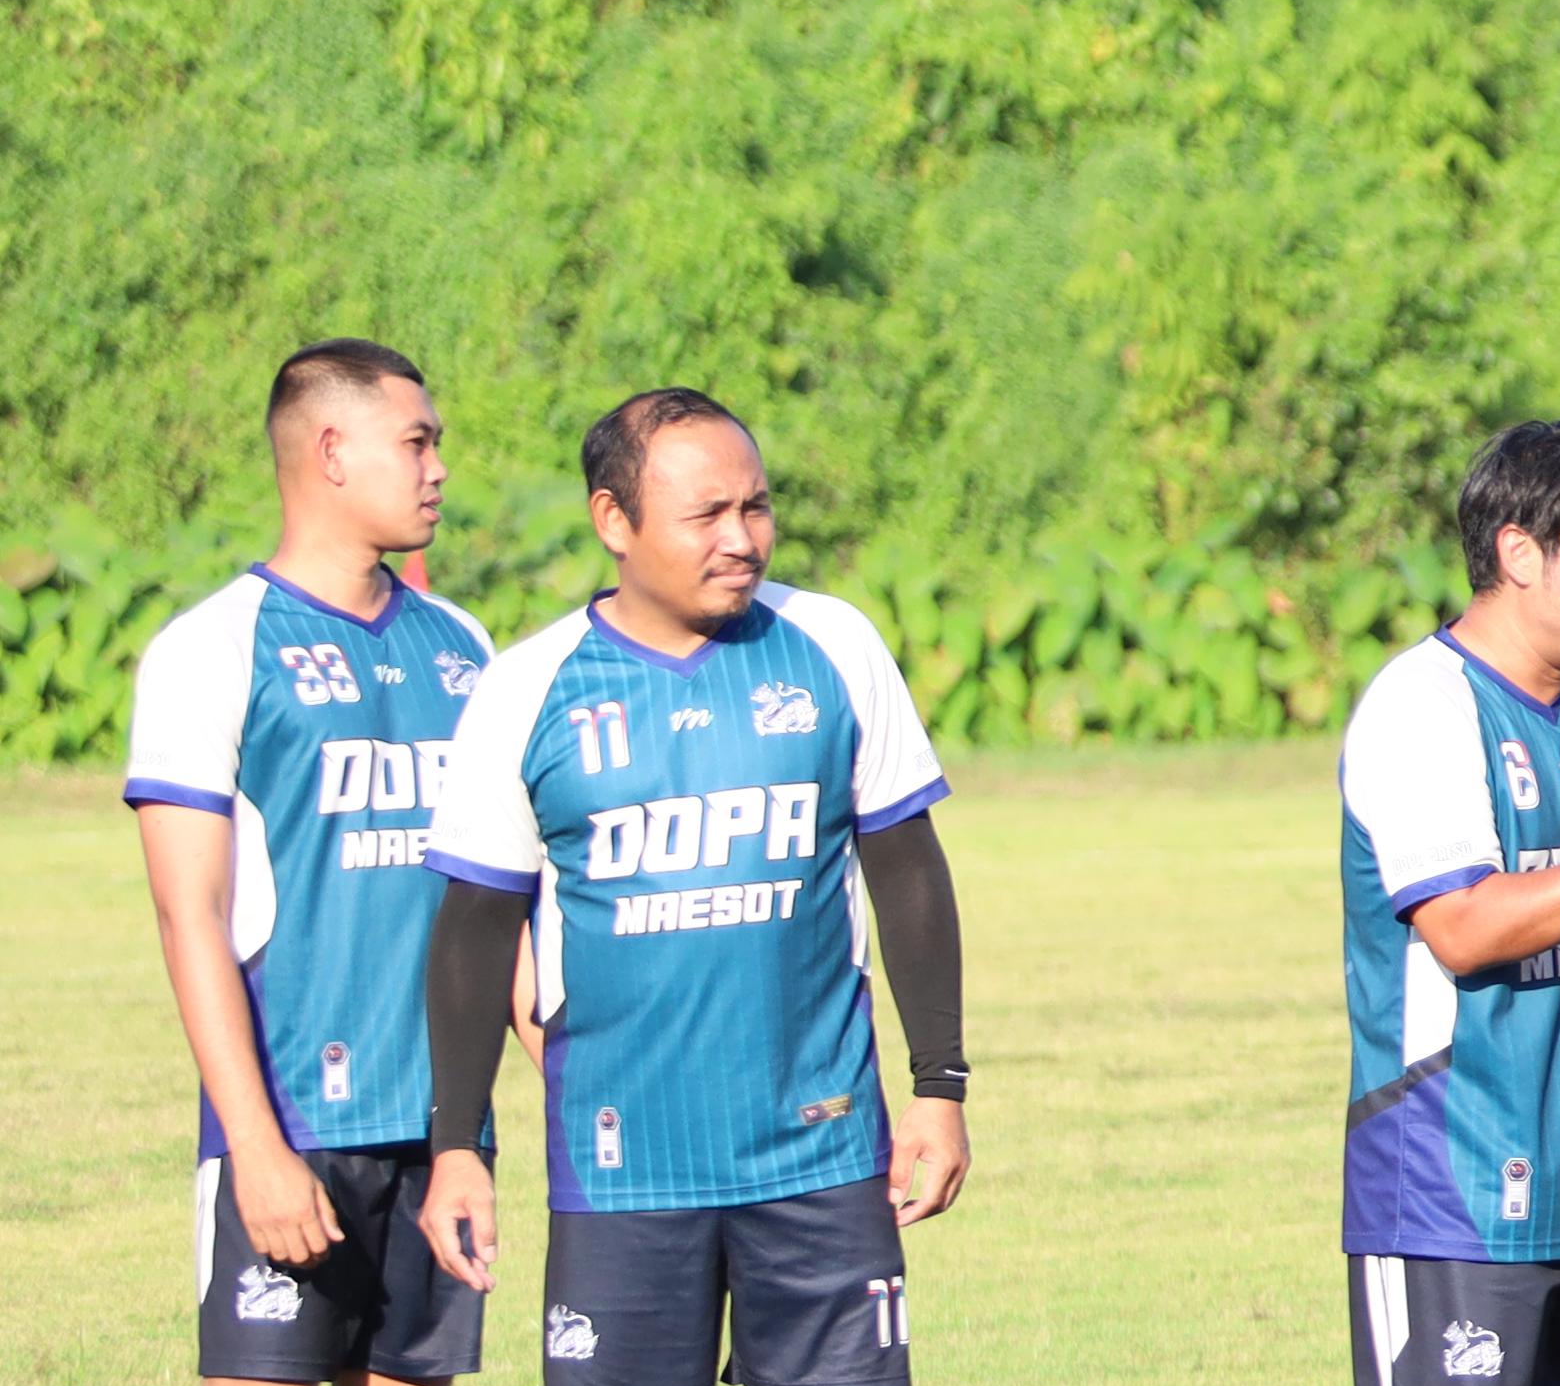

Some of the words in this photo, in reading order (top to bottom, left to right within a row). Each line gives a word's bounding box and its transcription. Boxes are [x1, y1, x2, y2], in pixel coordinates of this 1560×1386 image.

[279, 643, 362, 706] 33
[568, 700, 631, 775] 11
[318, 737, 452, 815] DOP
[1500, 739, 1541, 810] 6
[341, 828, 430, 870] MAE
[587, 782, 821, 881] DOPA
[613, 879, 804, 936] MAESOT
[866, 1275, 910, 1348] 11
